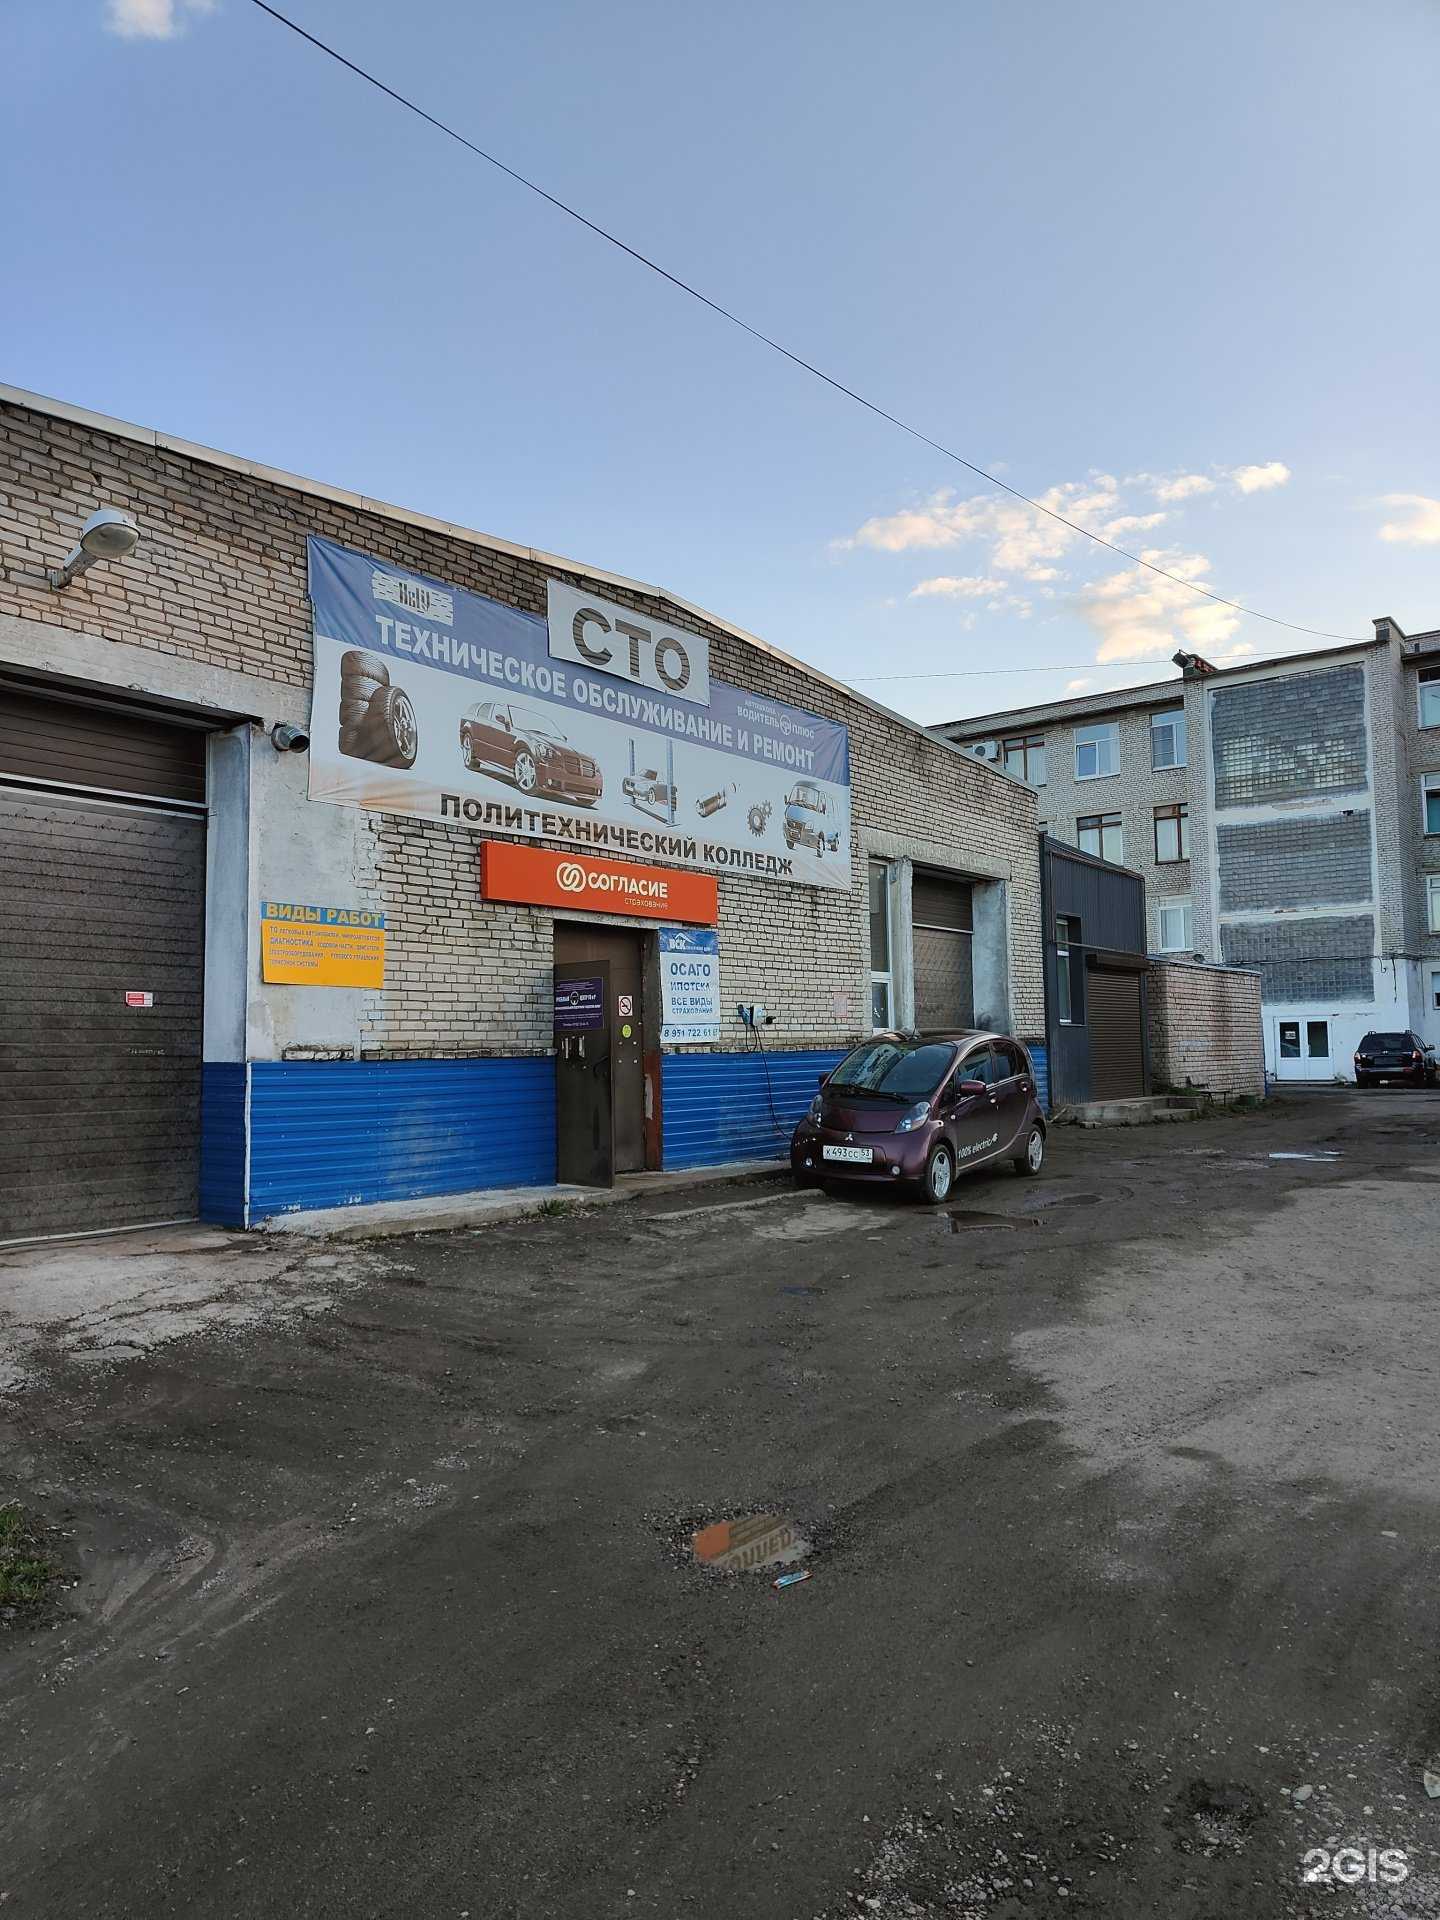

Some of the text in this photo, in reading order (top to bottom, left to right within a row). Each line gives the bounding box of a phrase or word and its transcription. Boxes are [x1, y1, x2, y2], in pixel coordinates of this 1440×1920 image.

[572, 607, 691, 691] СТО
[375, 614, 815, 770] ТЕХНИЧЕСКОЕ ОБСЛУЖИВАНИЕ И РЕМОНТ
[737, 706, 815, 739] ВОДИТЕЛЬ ПЛЮС
[440, 793, 794, 875] ПОЛИТЕХНИЧЕСКИЙ КОЛЛЕДЖ
[588, 872, 668, 898] СОГЛАСИЕ
[266, 903, 381, 927] ВИДЫ РАБОТ
[670, 963, 711, 977] ОСАГО
[670, 981, 711, 991] ИПОТЕКА
[671, 997, 713, 1007] ВСЕ ВИДЫ
[672, 1007, 713, 1015] СТРАХОВАНИЯ
[664, 1029, 670, 1037] 8
[671, 1029, 685, 1038] 951
[688, 1029, 701, 1037] 722
